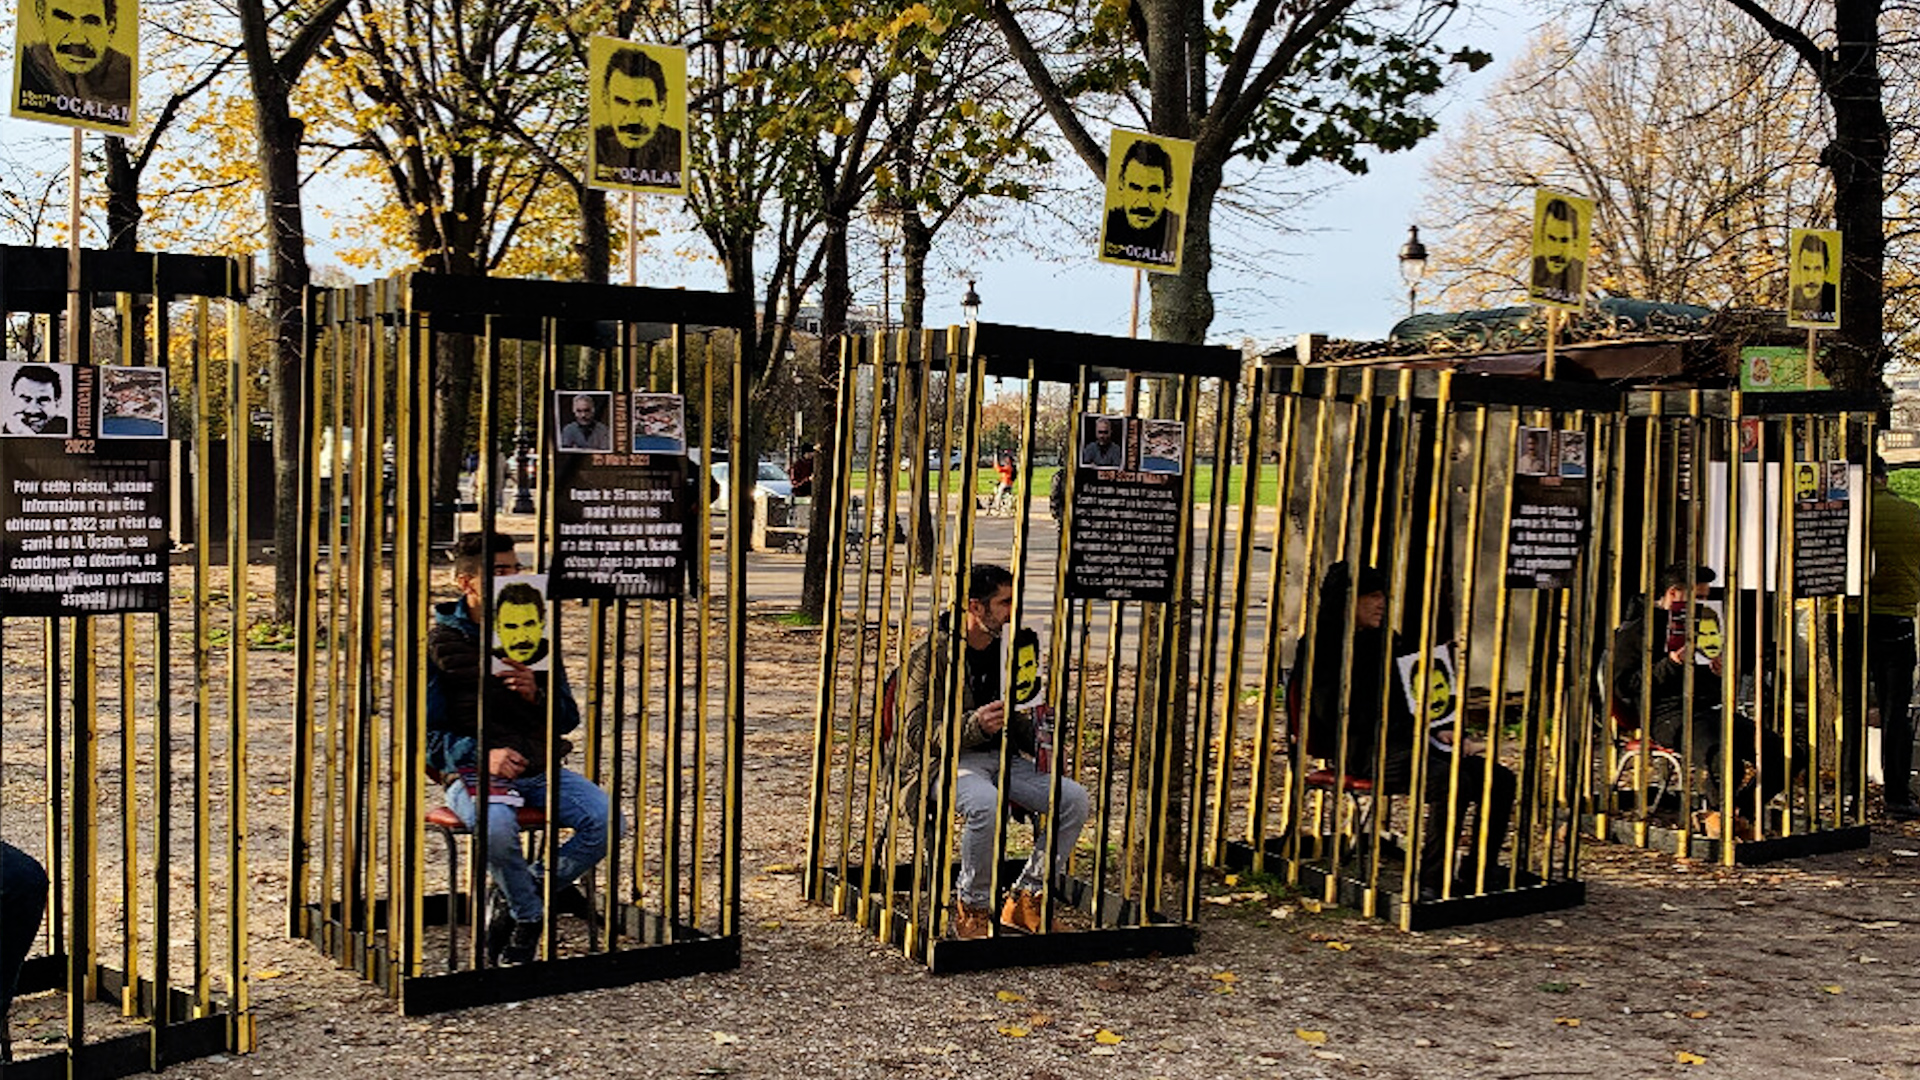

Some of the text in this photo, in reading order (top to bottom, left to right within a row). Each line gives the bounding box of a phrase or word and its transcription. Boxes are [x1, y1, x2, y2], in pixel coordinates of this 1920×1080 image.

[65, 440, 95, 453] 2022
[14, 479, 153, 494] Pour cette raison, aucune
[107, 501, 121, 513] pu
[122, 497, 146, 511] être
[5, 517, 51, 531] obtenue
[53, 518, 68, 531] en
[69, 517, 97, 531] 2022
[99, 518, 117, 530] sur
[148, 516, 163, 529] de
[21, 535, 53, 551] santé
[55, 535, 69, 549] de
[10, 555, 71, 570] conditions
[73, 555, 87, 567] de
[144, 553, 157, 565] sa
